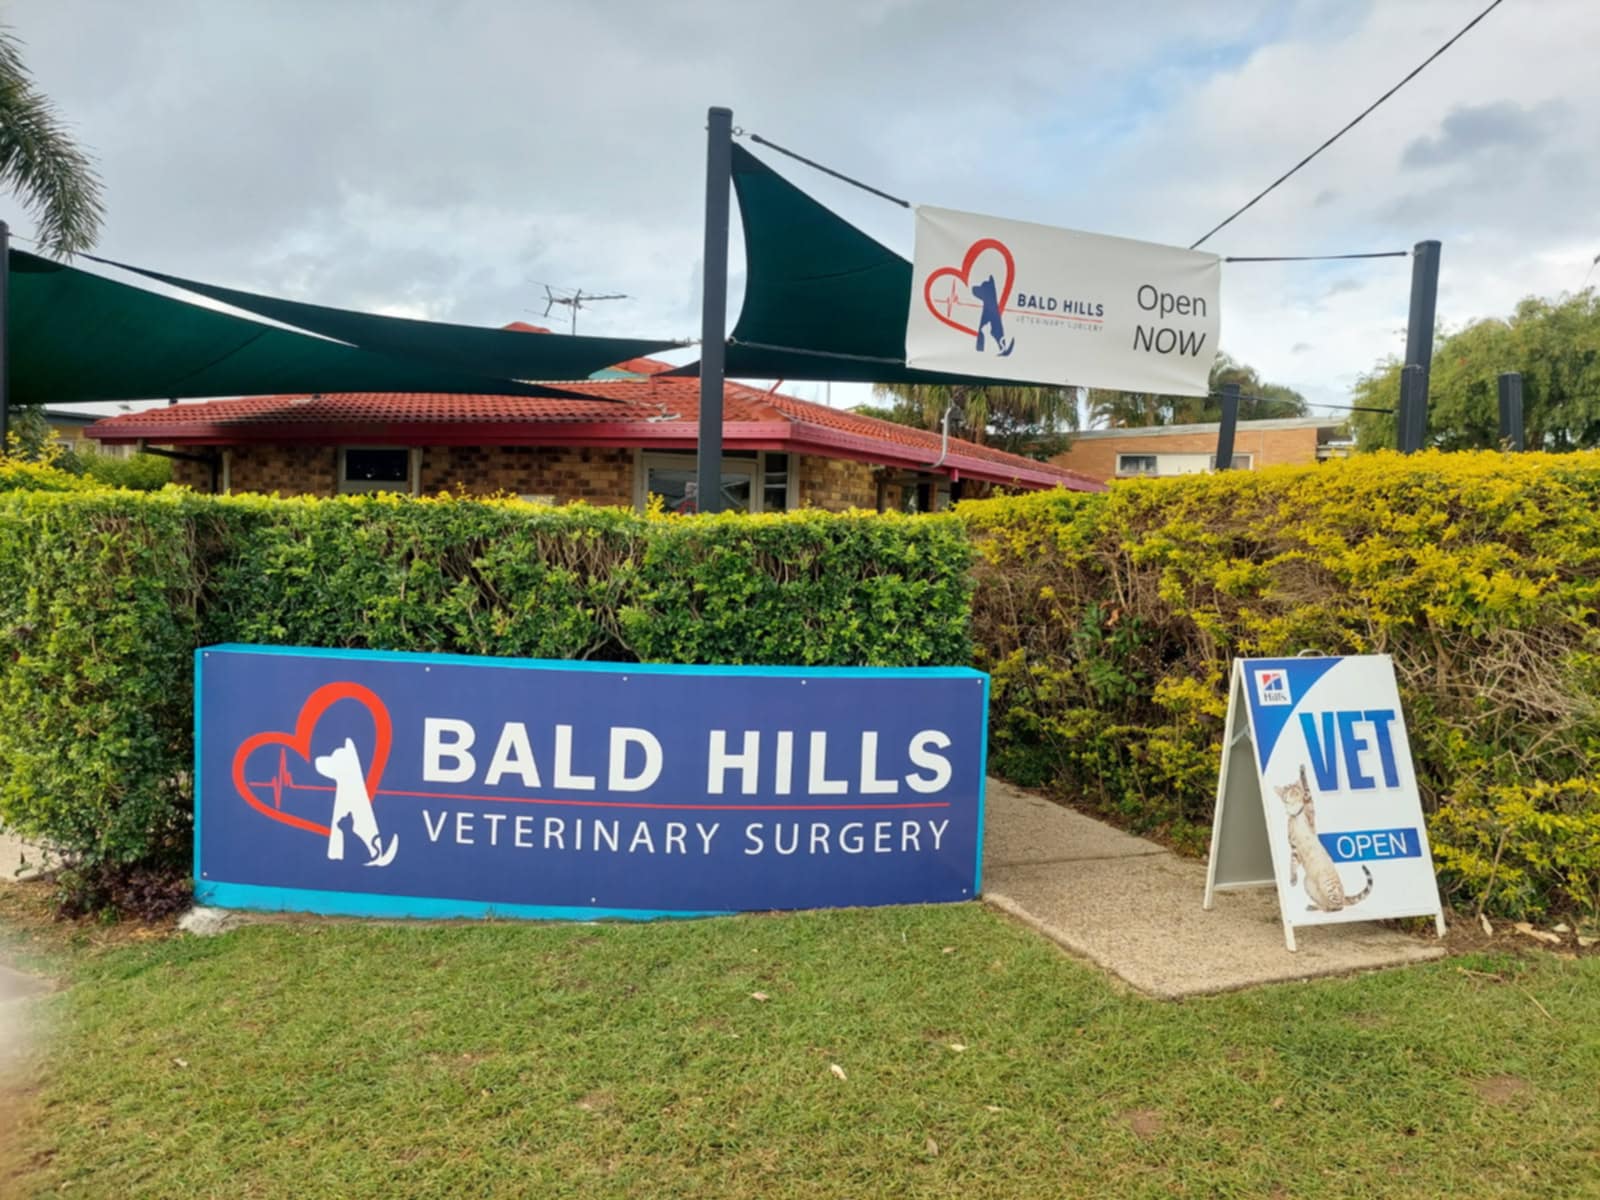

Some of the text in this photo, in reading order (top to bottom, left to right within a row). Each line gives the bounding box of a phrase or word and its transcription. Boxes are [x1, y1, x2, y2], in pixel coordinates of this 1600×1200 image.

[1017, 293, 1104, 317] BALD HILLS
[1137, 284, 1206, 319] Open
[1133, 324, 1206, 357] NOW
[422, 717, 952, 795] BALD HILLS
[1298, 709, 1400, 792] VET
[422, 809, 950, 855] VETERINARY SURGERY
[1336, 832, 1408, 859] OPEN
